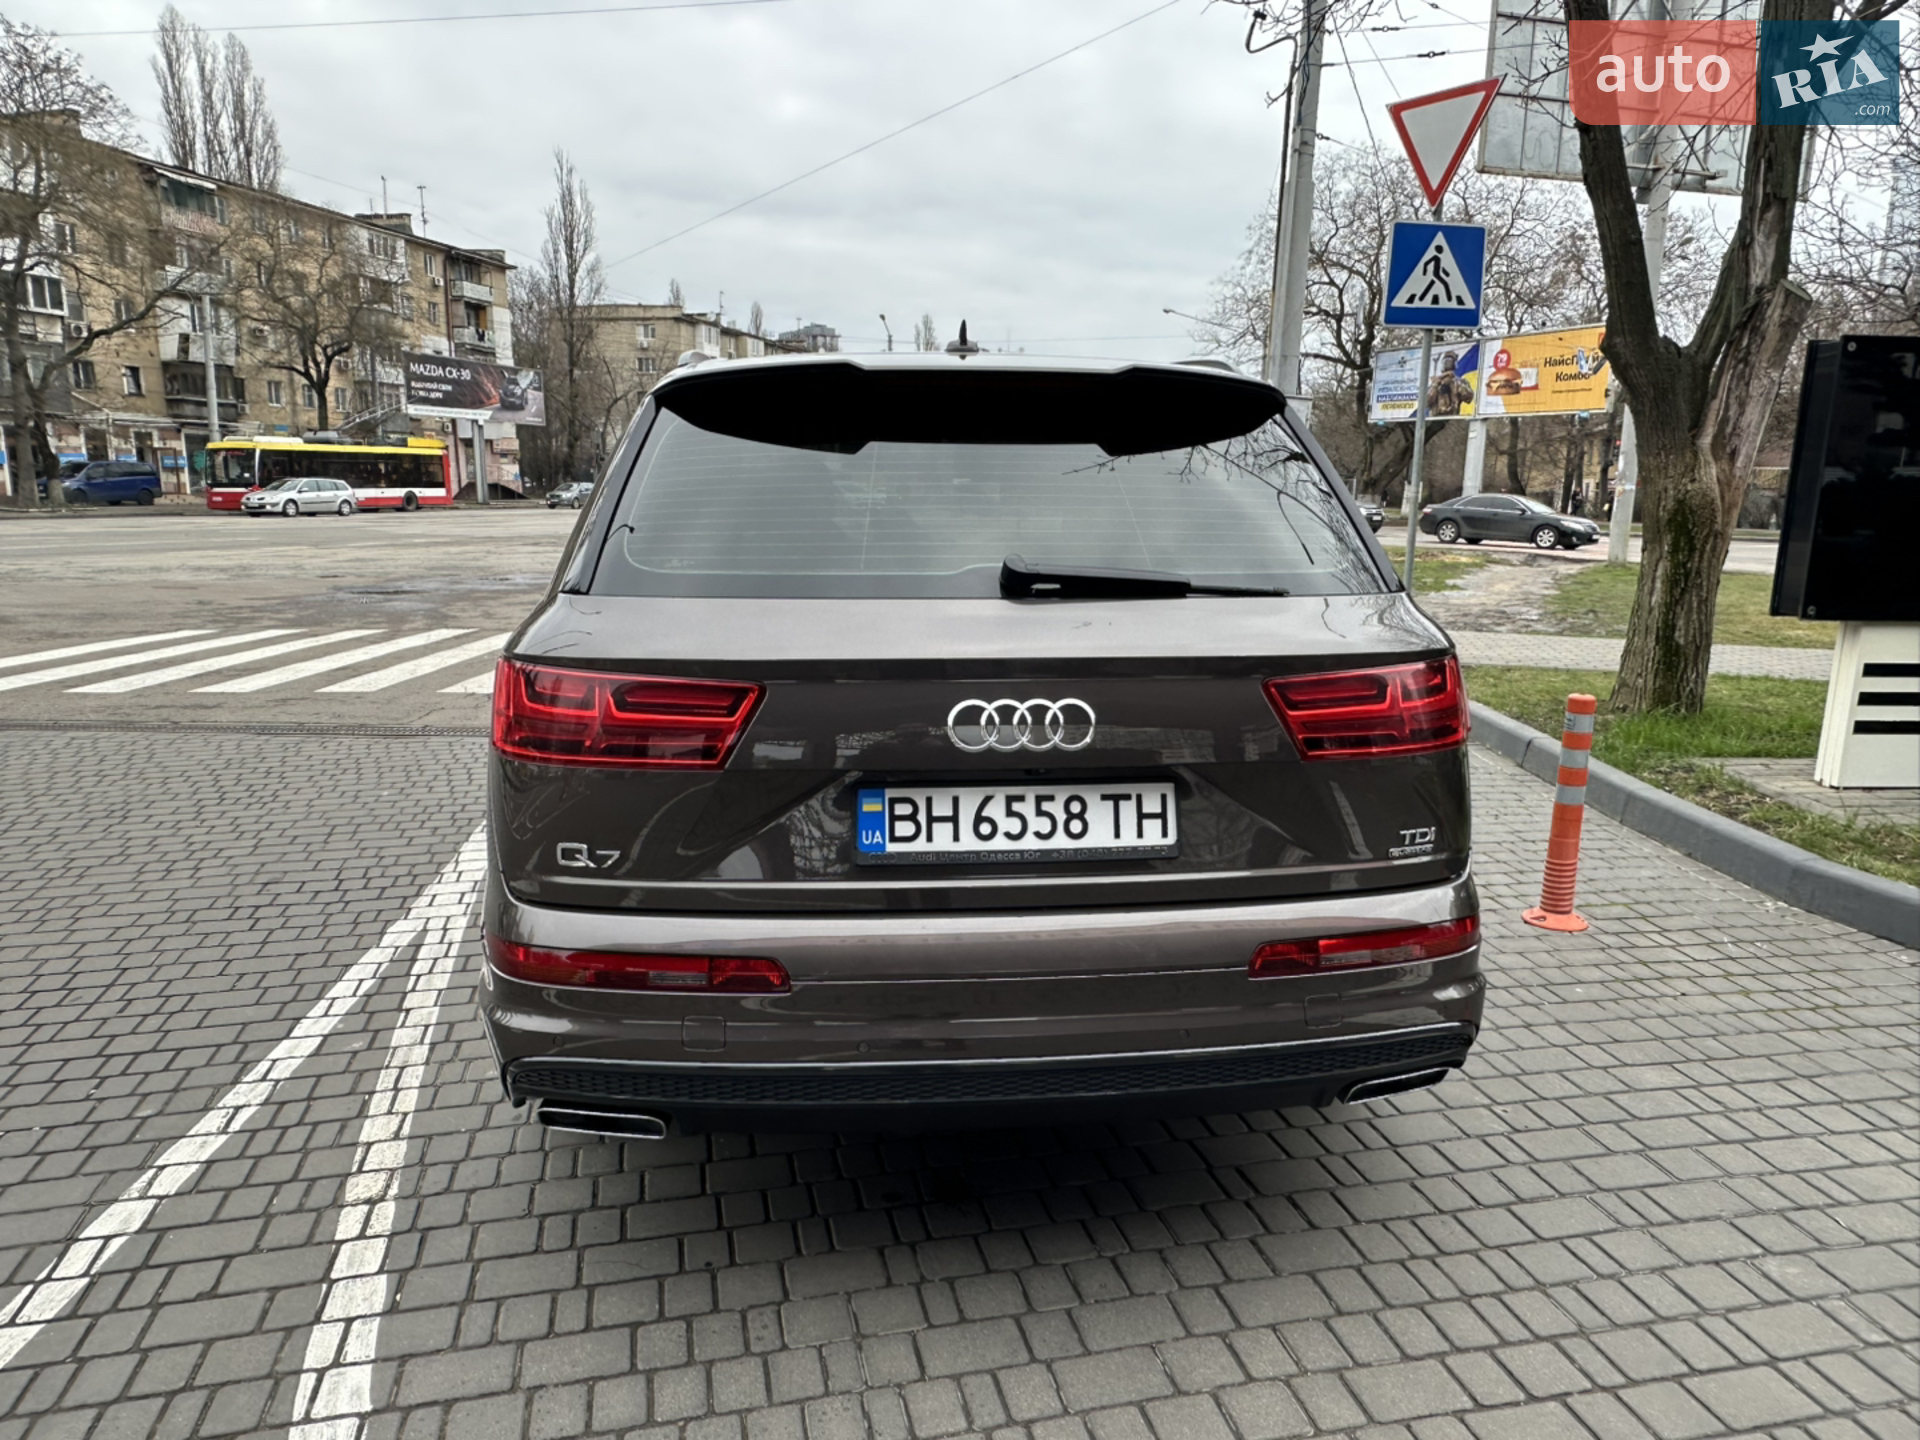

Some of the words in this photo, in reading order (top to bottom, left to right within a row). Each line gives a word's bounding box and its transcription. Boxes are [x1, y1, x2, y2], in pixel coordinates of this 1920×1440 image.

[409, 362, 444, 378] MAZDA
[445, 366, 471, 381] CX-30
[887, 796, 960, 843] BH
[972, 794, 1089, 842] 6558
[1100, 793, 1168, 839] TH
[862, 830, 883, 845] UA
[556, 842, 621, 868] Q7
[909, 851, 937, 862] Audi
